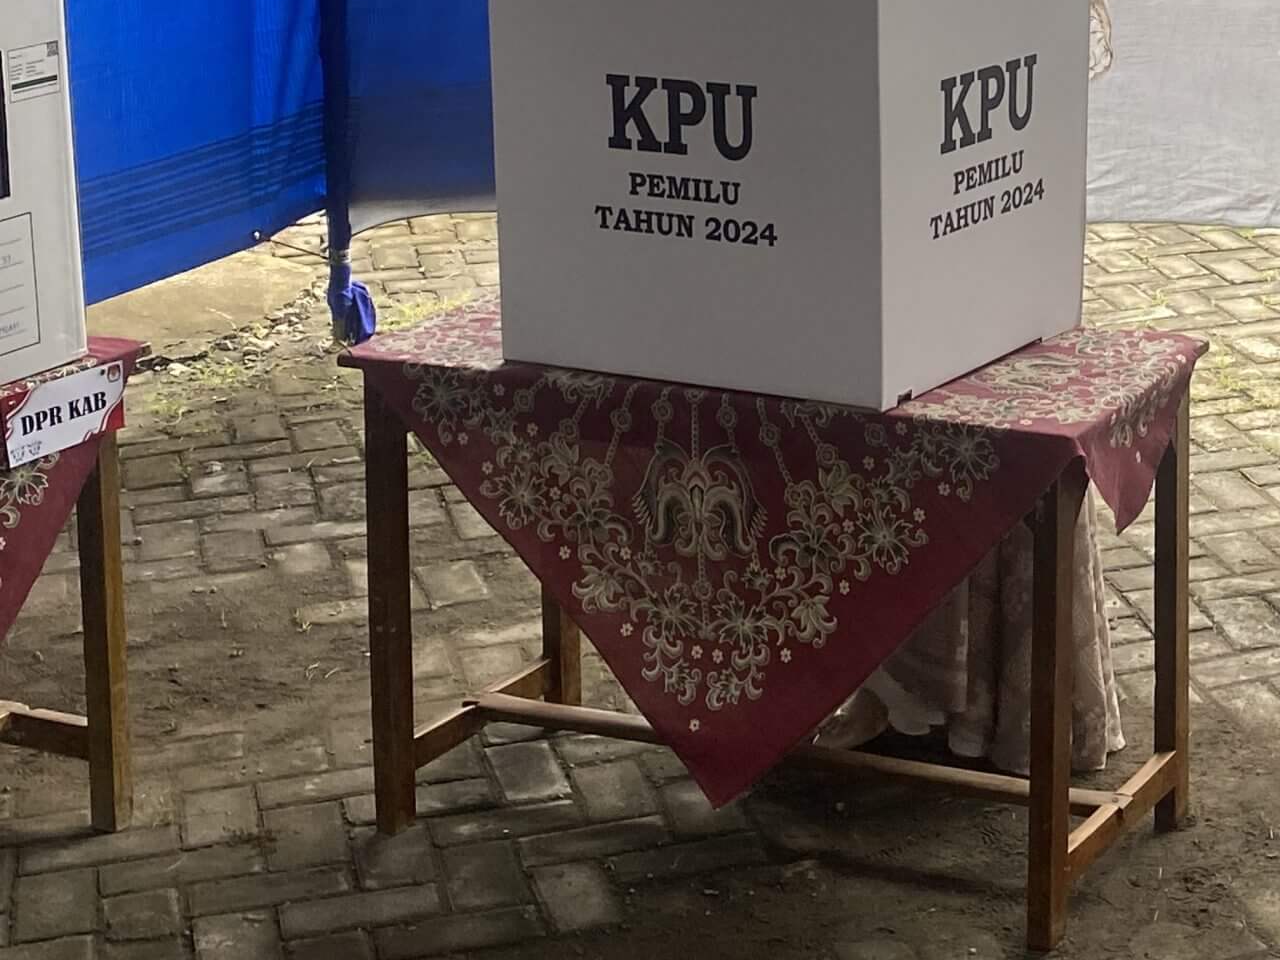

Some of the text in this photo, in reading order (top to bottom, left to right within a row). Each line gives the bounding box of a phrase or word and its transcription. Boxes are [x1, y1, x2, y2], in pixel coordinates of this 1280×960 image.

[606, 73, 758, 161] KPU
[940, 53, 1037, 155] KPU
[629, 172, 741, 205] PEMILU
[953, 149, 1024, 195] PEMILU
[594, 205, 778, 247] TAHUN 2024
[929, 178, 1044, 240] TAHUN 2024
[21, 391, 107, 436] DPR KAB
